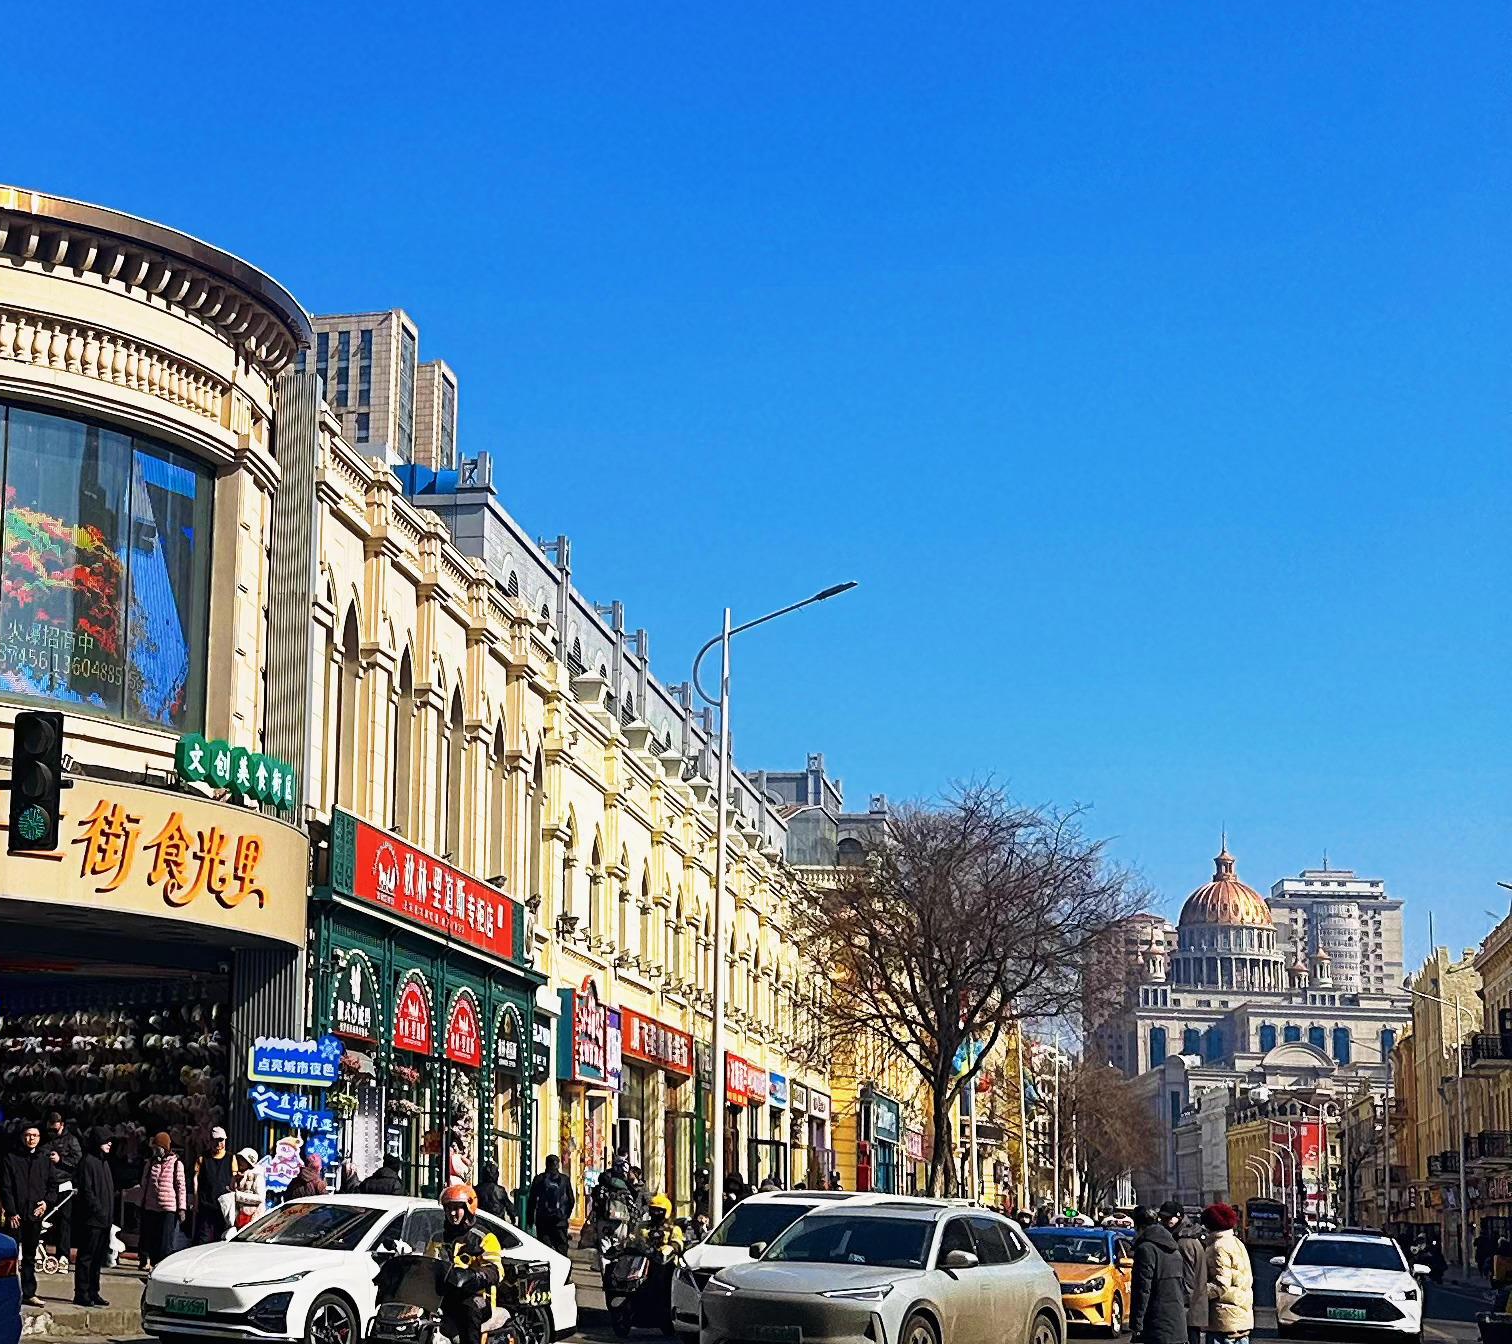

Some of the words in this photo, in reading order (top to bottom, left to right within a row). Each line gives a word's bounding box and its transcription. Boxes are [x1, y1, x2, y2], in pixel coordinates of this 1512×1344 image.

[187, 743, 294, 802] 文创美食街区
[257, 1057, 335, 1077] 点亮城市夜色
[276, 1094, 309, 1111] 直通
